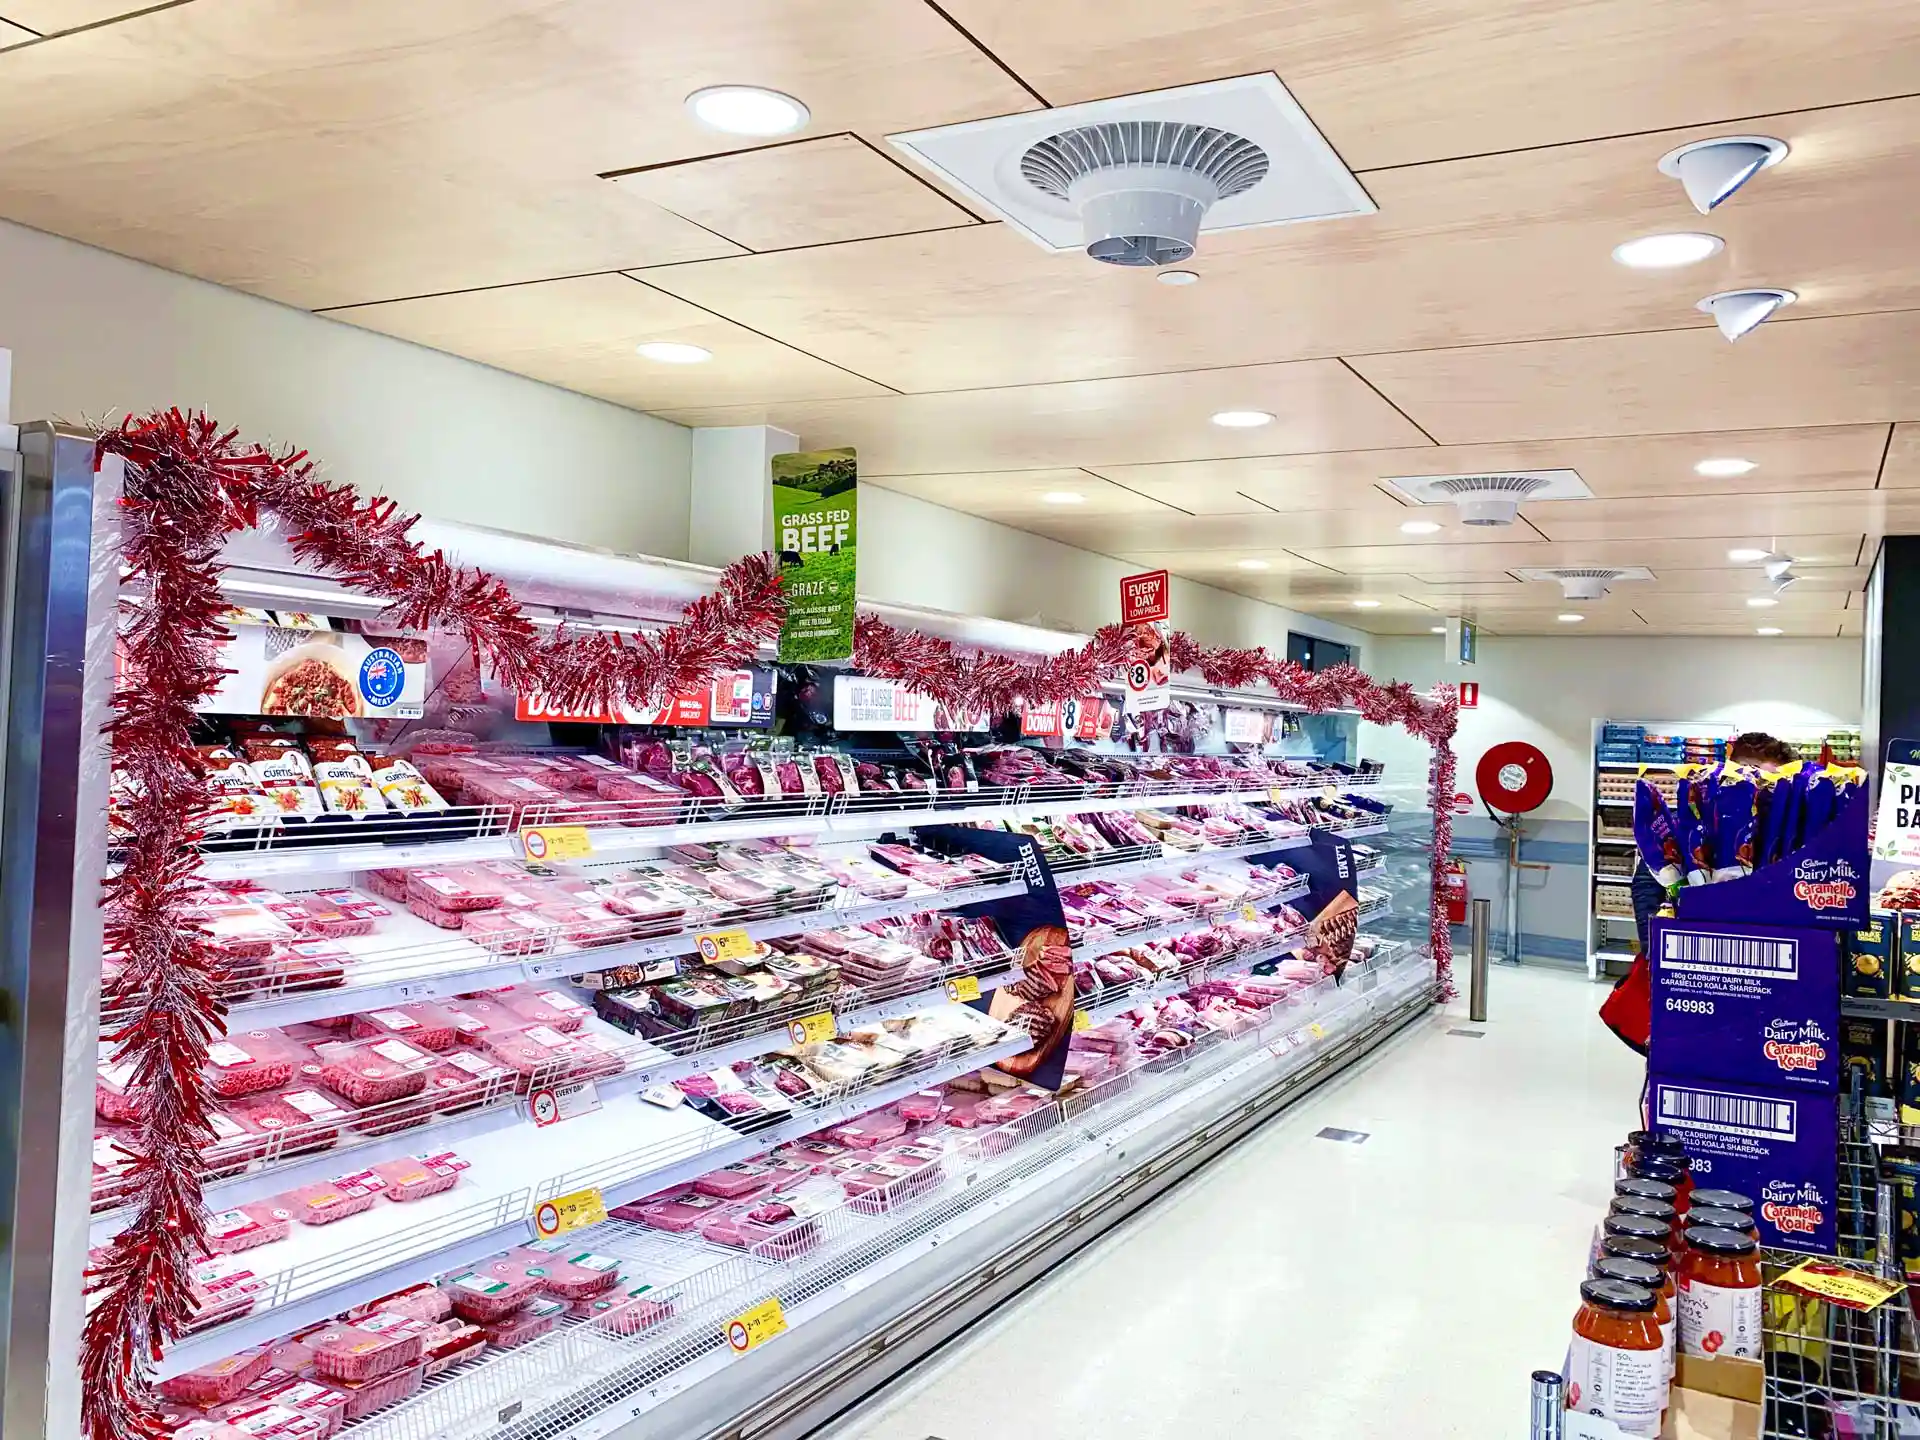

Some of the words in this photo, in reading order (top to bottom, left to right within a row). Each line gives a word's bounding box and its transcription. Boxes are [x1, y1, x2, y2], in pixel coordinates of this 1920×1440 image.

[782, 512, 823, 527] GRASS
[827, 509, 850, 523] FED
[782, 523, 850, 553] BEEF
[791, 581, 825, 597] GRAZE
[1128, 580, 1161, 597] EVERY
[1135, 593, 1156, 608] DAY
[806, 605, 827, 614] AUSSIE
[828, 604, 842, 613] BEEF
[1129, 607, 1145, 618] LOW
[1144, 604, 1161, 615] PRICE
[363, 651, 404, 675] AUSTRALIAN
[1130, 666, 1145, 684] $8
[370, 696, 392, 706] MEAT
[850, 687, 869, 707] 100%
[871, 687, 893, 707] AUSSIE
[894, 689, 919, 722] BEEF
[1062, 700, 1076, 730] $8
[1026, 715, 1056, 733] DOWN
[263, 769, 294, 778] CURTIS
[327, 769, 356, 779] CURTIS
[385, 772, 410, 783] CURTIS
[1018, 842, 1045, 888] BEEF
[1335, 844, 1349, 879] LAMB
[1794, 867, 1828, 882] Dairy
[1829, 865, 1857, 879] Milk
[1794, 881, 1856, 900] Caramello
[1808, 894, 1847, 910] Koala
[1660, 978, 1703, 988] CARAMELLO
[1704, 982, 1728, 991] KOALA
[1729, 985, 1772, 994] SHAREPACK
[1671, 972, 1687, 981] 180g
[1687, 973, 1721, 983] CADBURY
[1721, 976, 1743, 985] DAIRY
[1744, 978, 1762, 986] MILK
[1665, 998, 1715, 1015] 649983
[1764, 1026, 1797, 1042] Dairy
[1799, 1026, 1827, 1041] Milk
[1763, 1040, 1826, 1060] Caramello
[1777, 1055, 1817, 1071] Koala
[555, 1085, 573, 1098] EVERY
[1684, 1130, 1718, 1140] CADBURY
[1719, 1134, 1741, 1144] DAIRY
[1741, 1137, 1760, 1146] MILK
[1701, 1140, 1725, 1149] KOALA
[1726, 1143, 1770, 1155] SHAREPACK
[1688, 1158, 1713, 1173] 983
[1762, 1188, 1795, 1204] Dairy
[1797, 1189, 1824, 1205] Milk
[1761, 1201, 1824, 1225] Caramello
[1775, 1218, 1815, 1233] Koala
